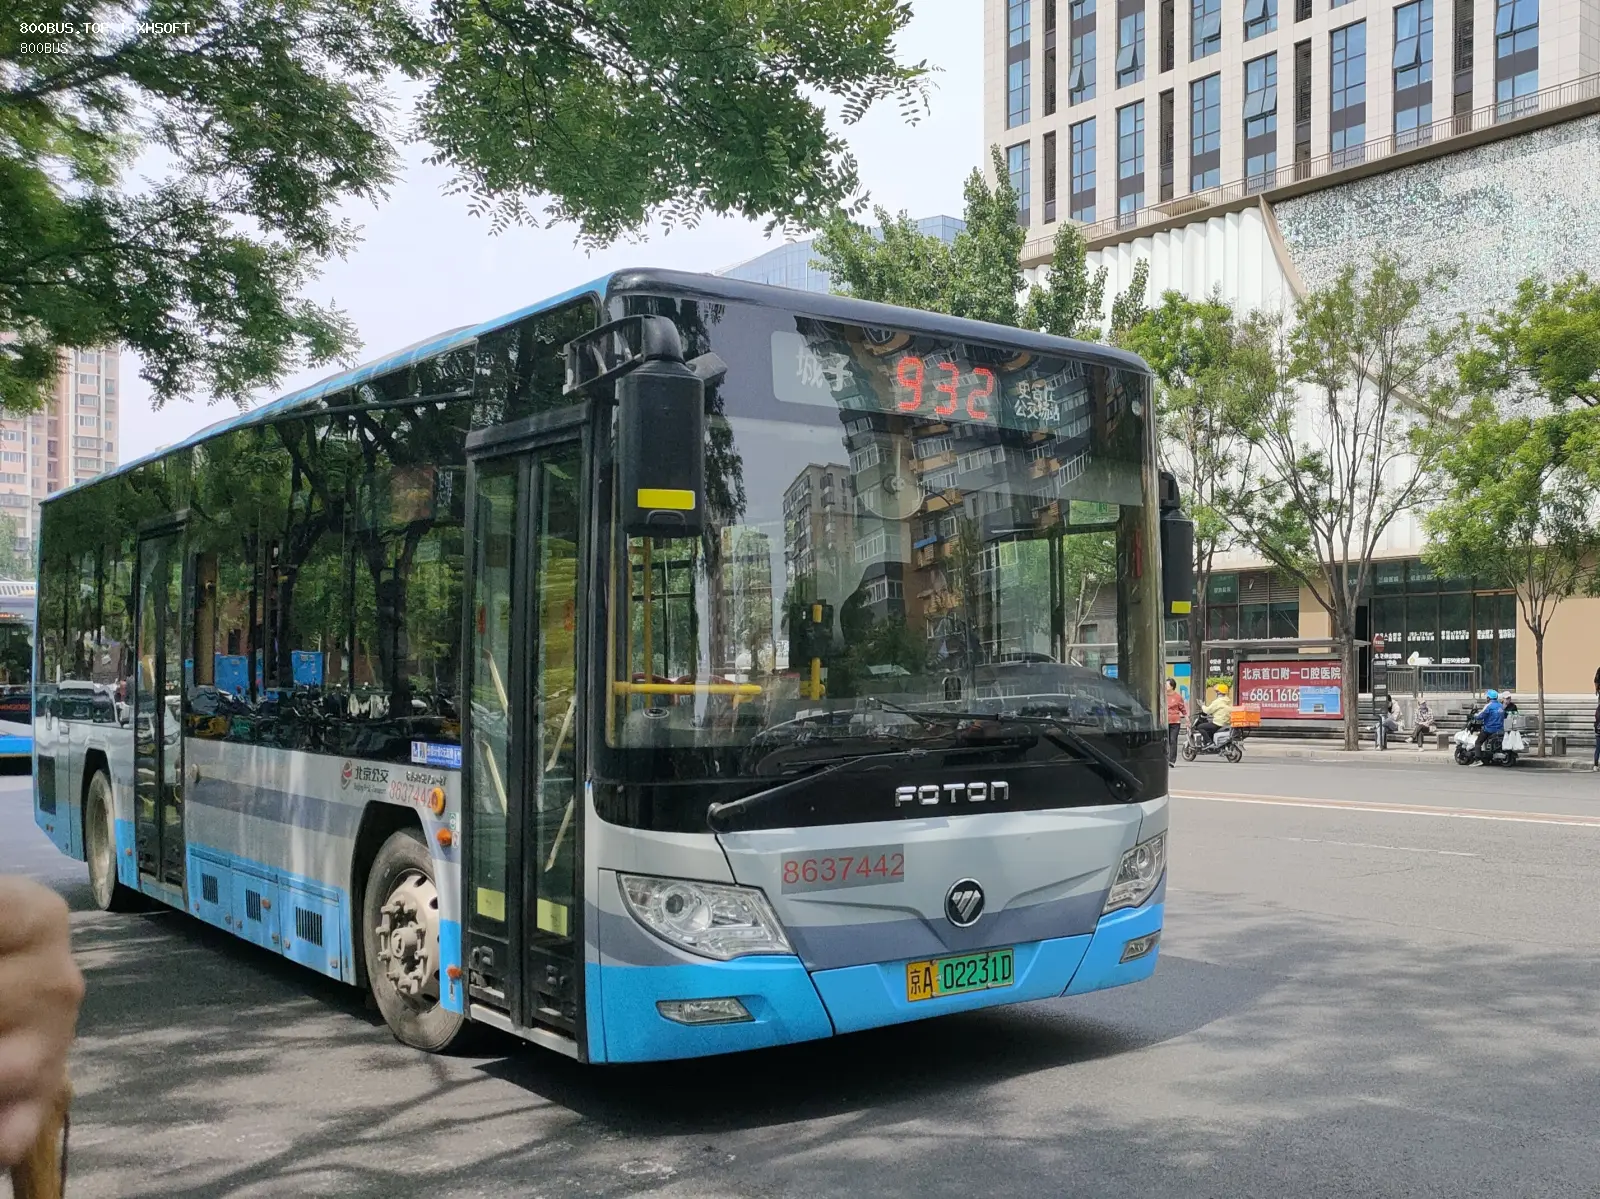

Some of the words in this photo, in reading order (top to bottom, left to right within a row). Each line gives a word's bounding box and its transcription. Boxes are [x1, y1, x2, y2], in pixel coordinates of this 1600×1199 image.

[897, 356, 994, 419] 932
[1014, 399, 1060, 421] 公交场站
[1242, 667, 1341, 680] 北京首口附一口腔医院
[354, 765, 390, 784] 北京公交
[894, 780, 1009, 808] FOTON
[783, 853, 905, 884] 8637442
